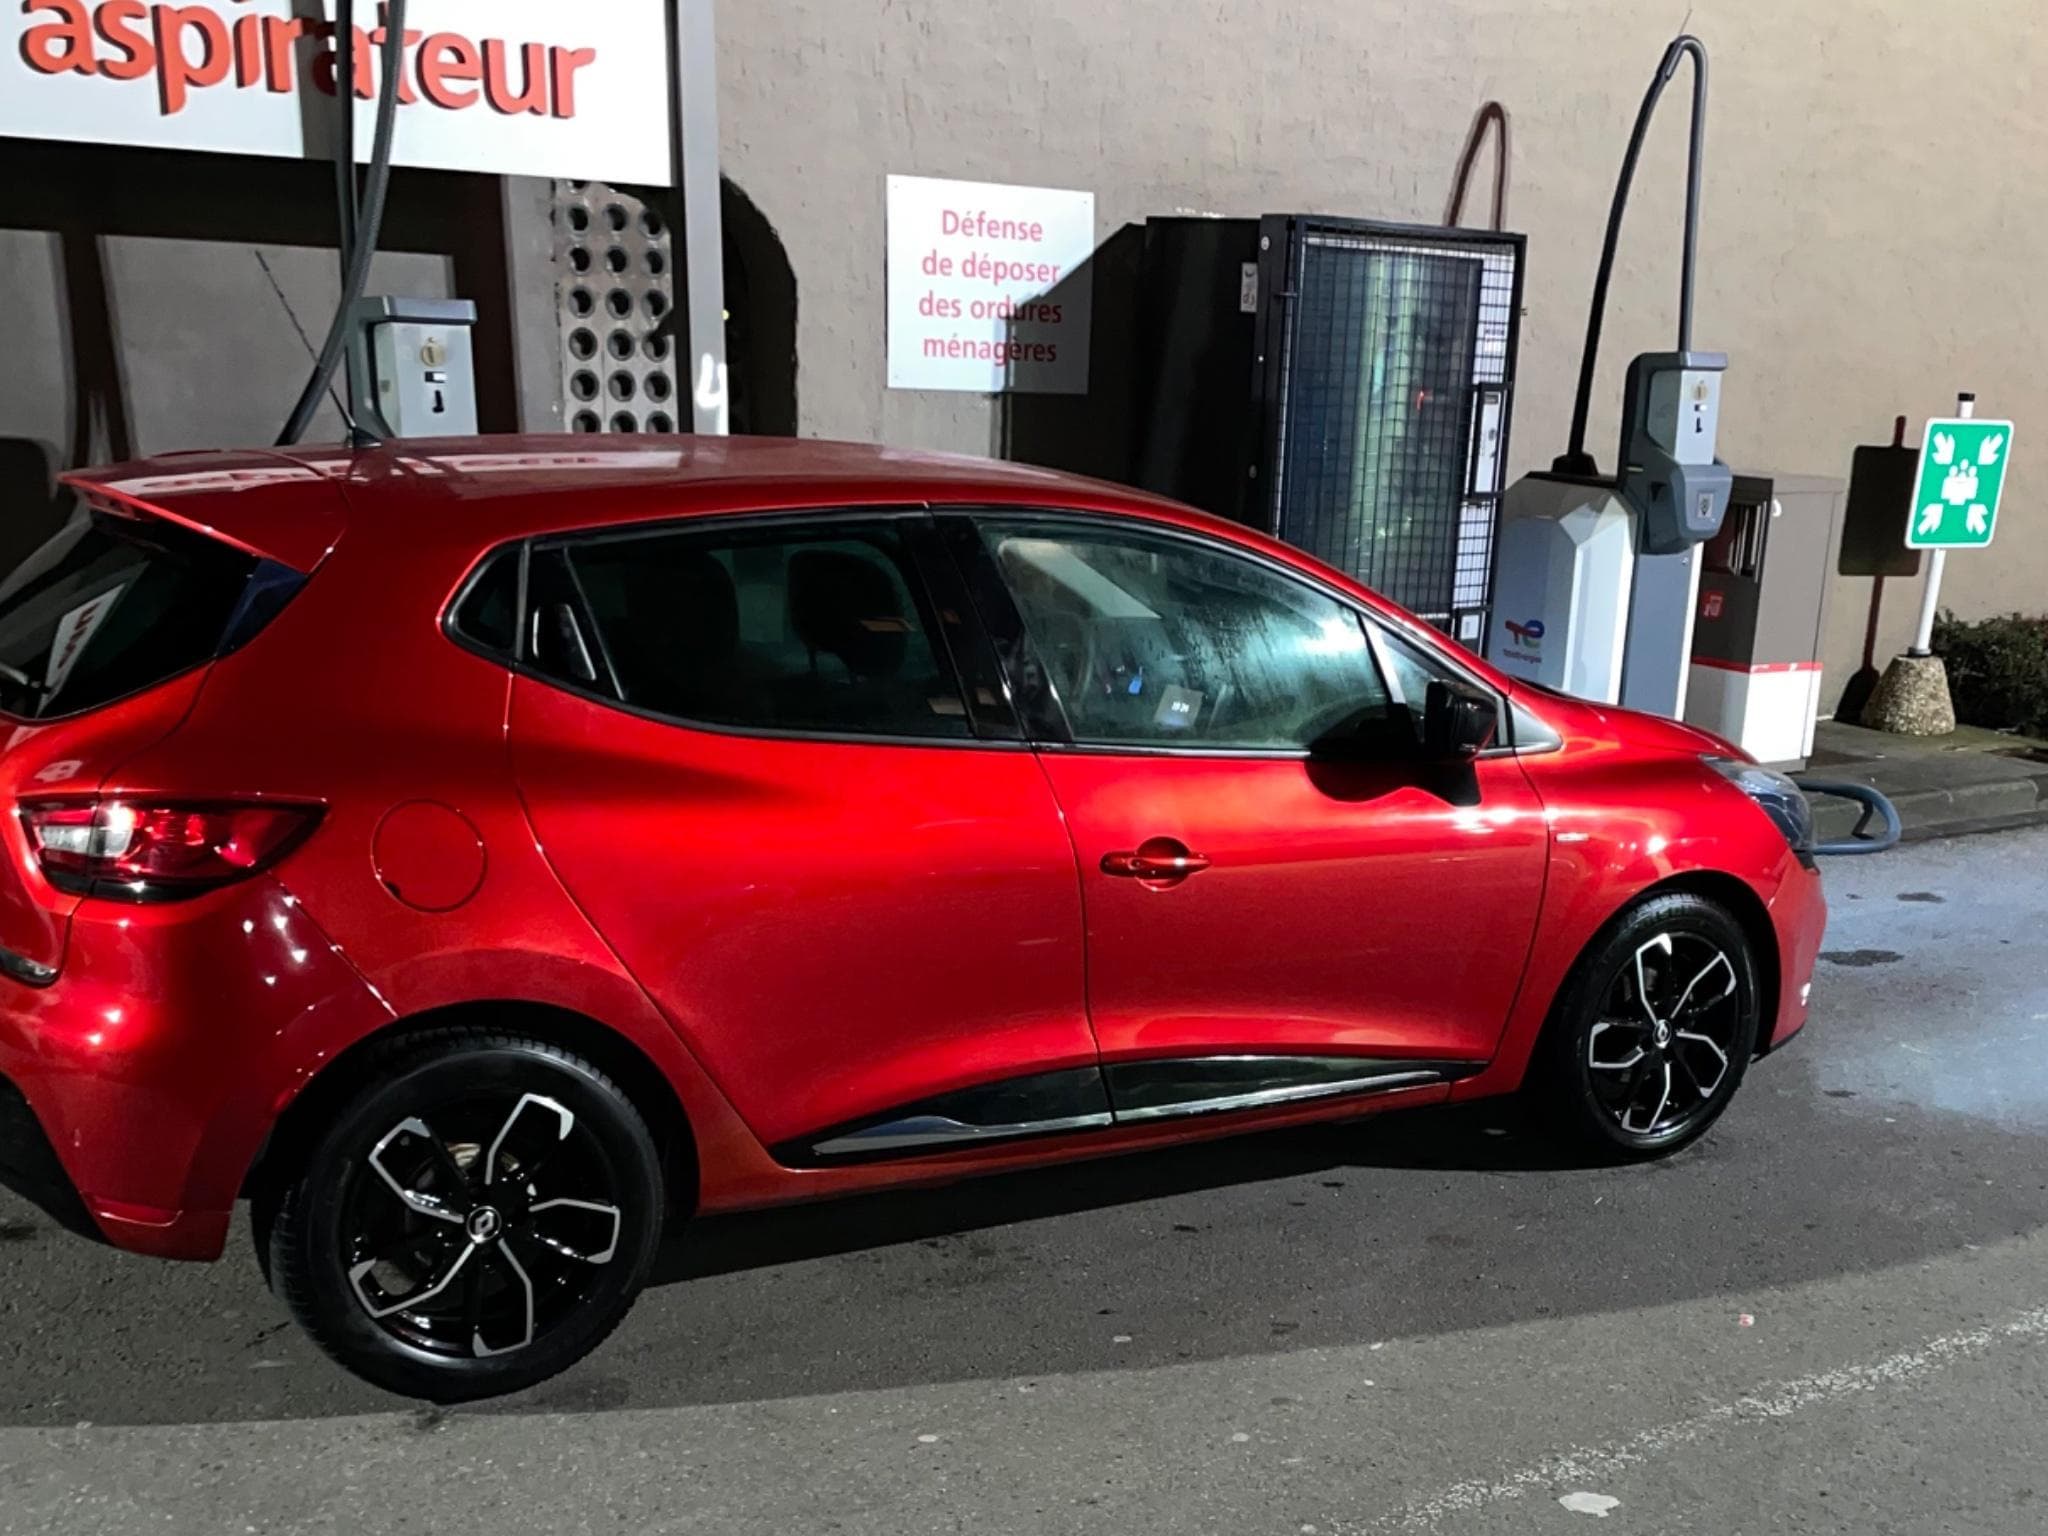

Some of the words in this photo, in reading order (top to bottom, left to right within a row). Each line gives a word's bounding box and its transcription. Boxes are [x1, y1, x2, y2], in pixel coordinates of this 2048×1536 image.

[942, 210, 1043, 242] Défense
[922, 249, 953, 276] de
[962, 252, 1060, 285] déposer
[919, 290, 961, 318] des
[970, 295, 1062, 324] ordures
[923, 334, 1057, 366] ménagères
